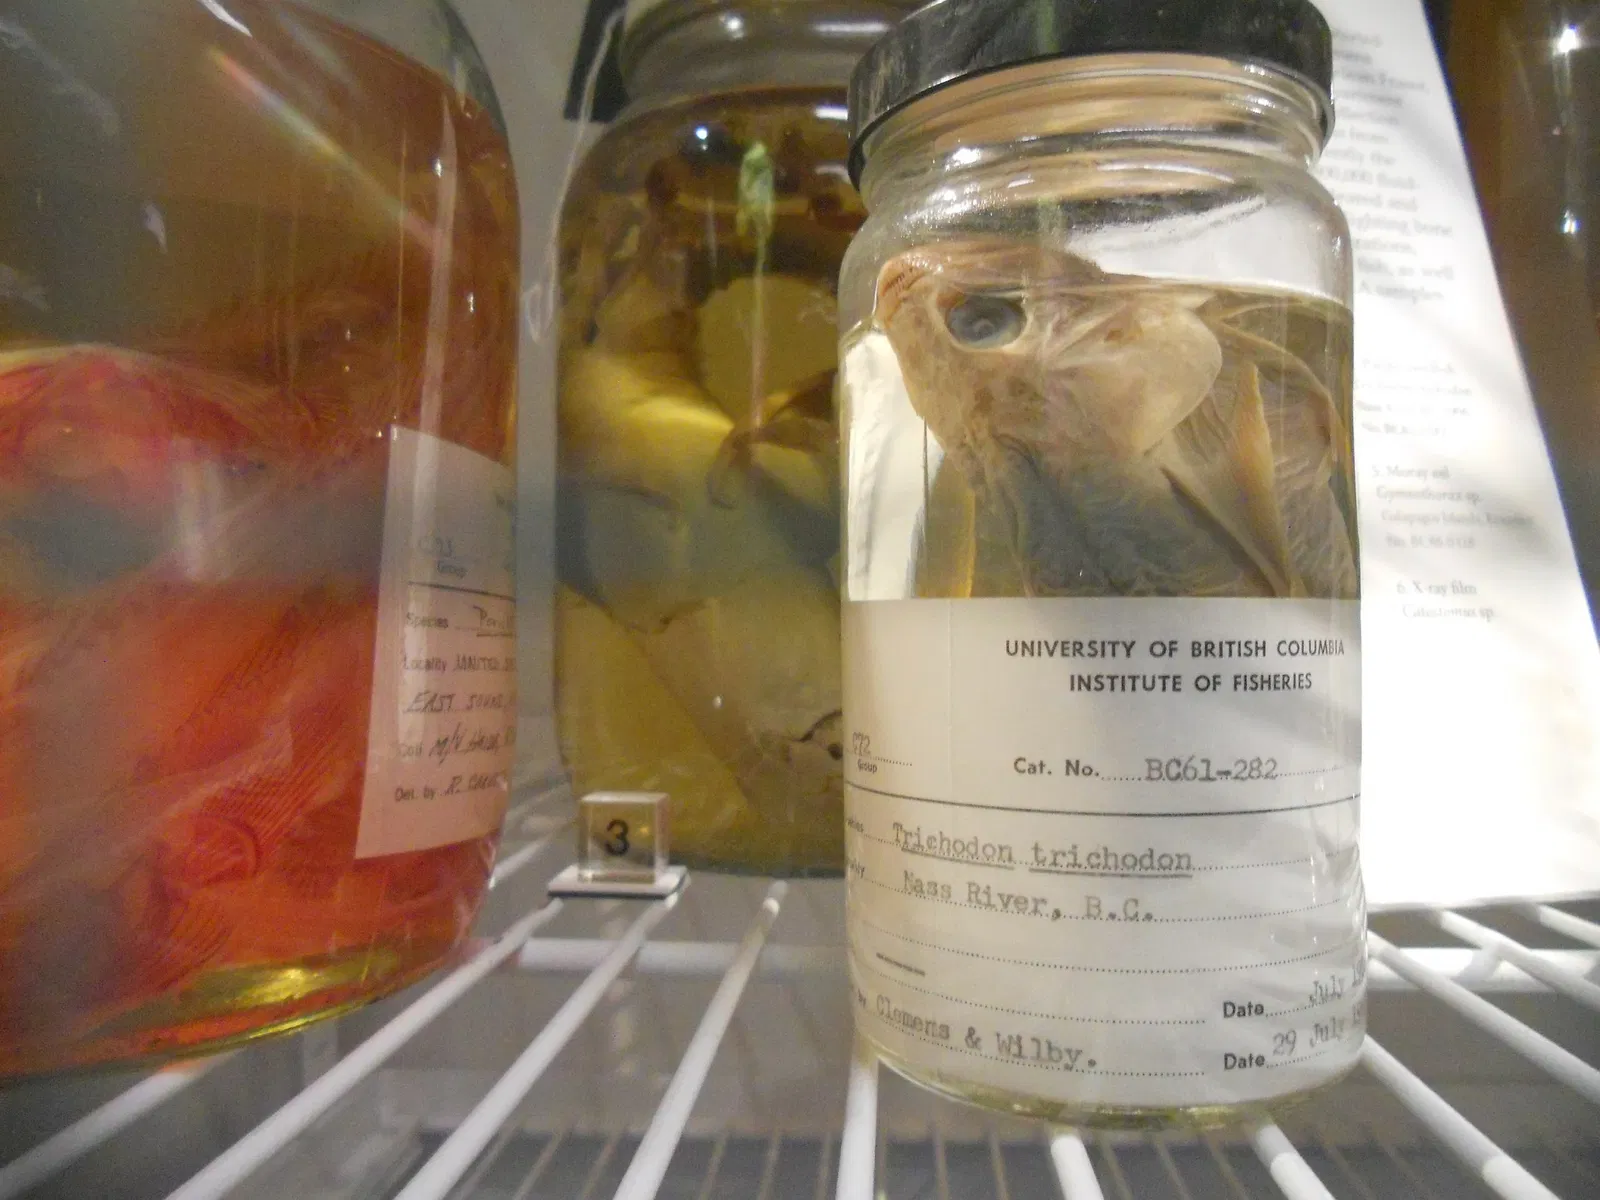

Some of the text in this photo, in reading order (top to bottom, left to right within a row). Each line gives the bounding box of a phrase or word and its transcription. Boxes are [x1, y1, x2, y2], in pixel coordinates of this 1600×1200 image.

[1005, 639, 1346, 658] UNIVERSITY OF BRITISH COLUMBIA
[1069, 672, 1313, 692] INSTITUTE OF FISHERIES
[403, 690, 457, 715] EAST
[857, 758, 878, 775] Group
[1013, 755, 1278, 782] Cat. No. BC61-282
[604, 819, 630, 857] 3
[893, 822, 1013, 863] Trichodon
[1031, 841, 1193, 873] trichodon
[903, 870, 953, 900] Nass
[966, 881, 1063, 921] River,
[1085, 895, 1153, 920] B.C.
[1223, 1001, 1265, 1018] Date
[1308, 975, 1346, 1007] July
[876, 994, 950, 1041] Clemens
[964, 1026, 983, 1050] &
[996, 1031, 1097, 1072] Wilby.
[1224, 1052, 1266, 1071] Date
[1272, 1028, 1297, 1056] 29
